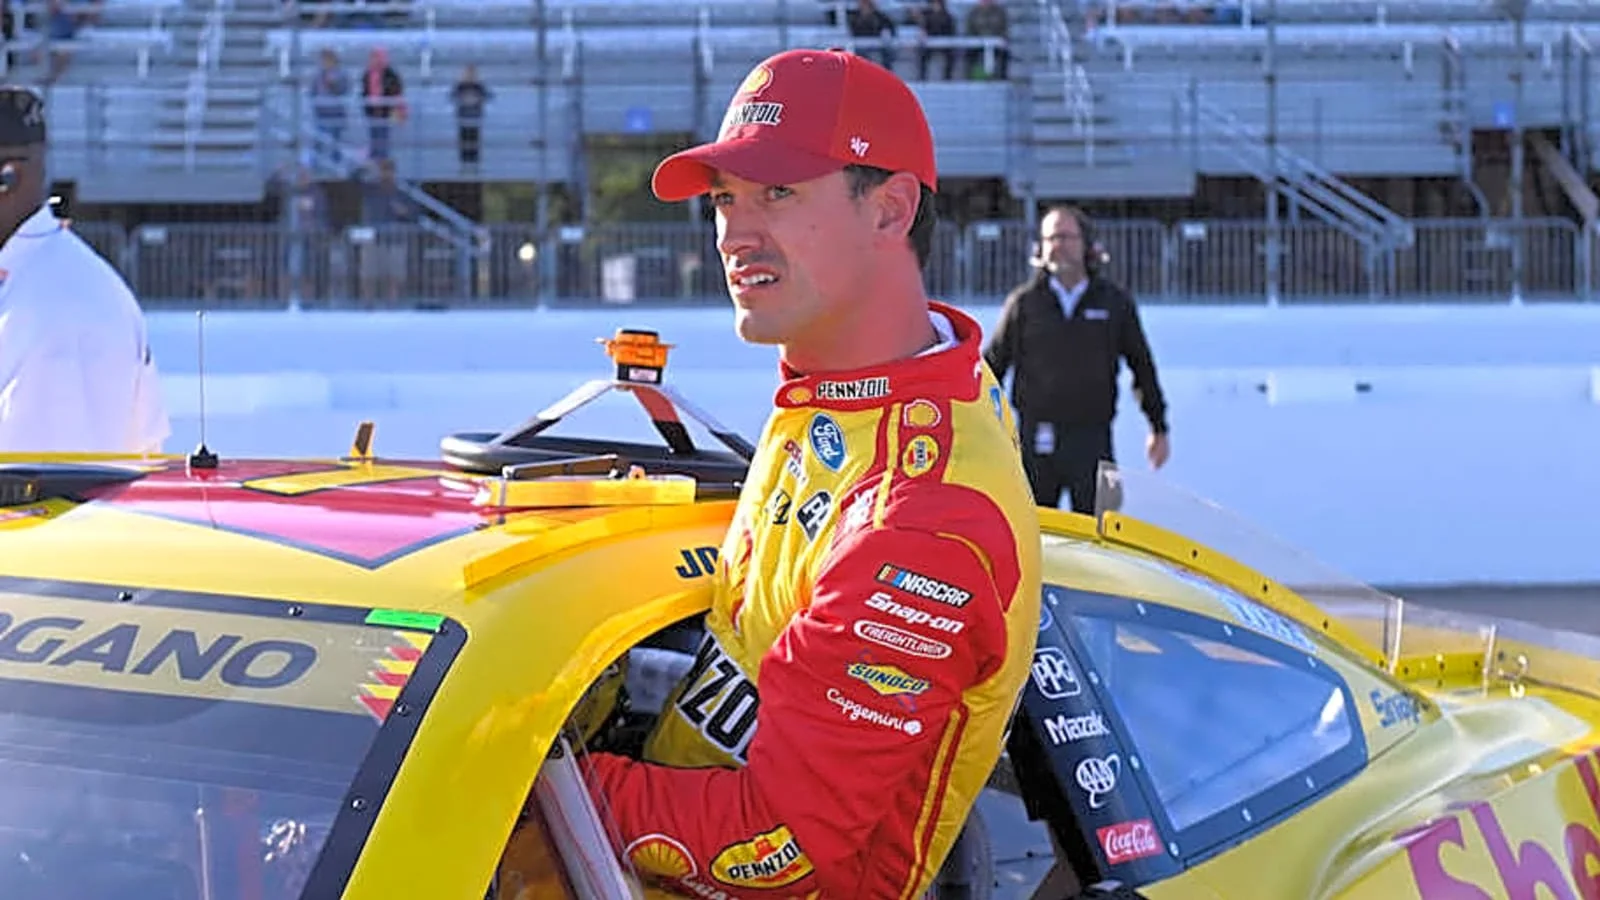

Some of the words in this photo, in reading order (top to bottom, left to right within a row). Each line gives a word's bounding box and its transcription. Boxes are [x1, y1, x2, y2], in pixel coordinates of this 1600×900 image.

[816, 378, 889, 399] PENNZOIL
[899, 571, 970, 607] NASCAR
[865, 592, 964, 634] Snap-on
[0, 612, 318, 689] GANO
[851, 664, 925, 692] SUNOCO
[1032, 653, 1074, 692] PPG
[827, 688, 903, 730] Capgemini
[1043, 709, 1111, 745] Mazak
[728, 839, 801, 880] PENNZO
